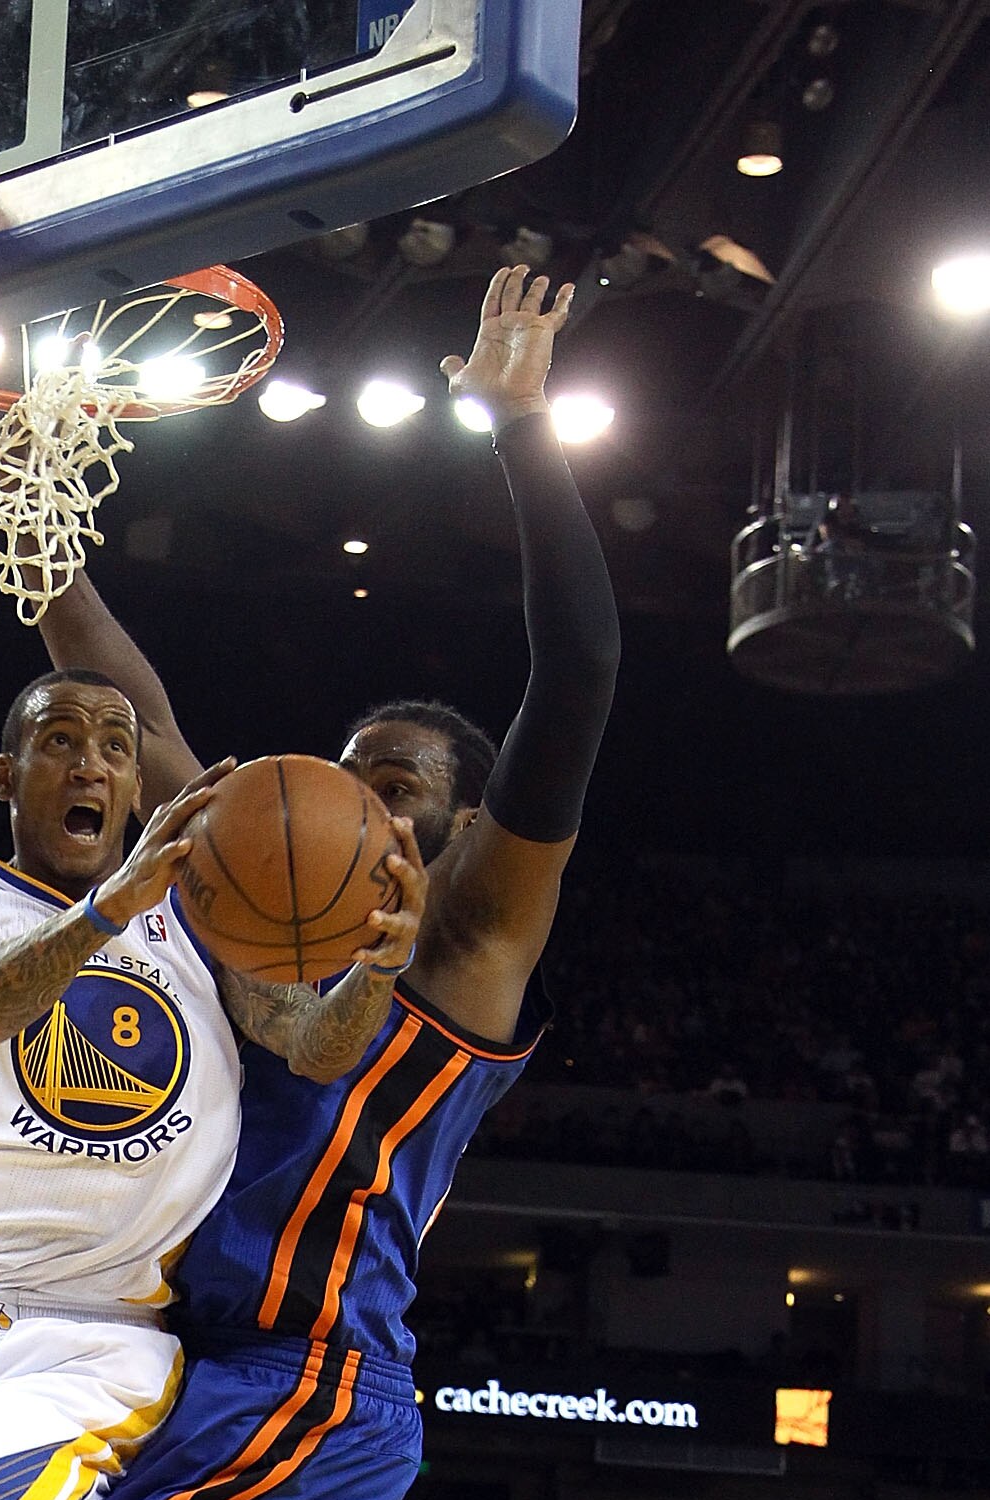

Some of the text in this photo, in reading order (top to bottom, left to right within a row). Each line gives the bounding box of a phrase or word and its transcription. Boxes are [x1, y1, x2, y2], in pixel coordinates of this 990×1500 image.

[368, 9, 410, 49] NB
[112, 1005, 141, 1048] 8
[10, 1103, 193, 1164] WARRIORS
[435, 1380, 698, 1428] cachecreek.com
